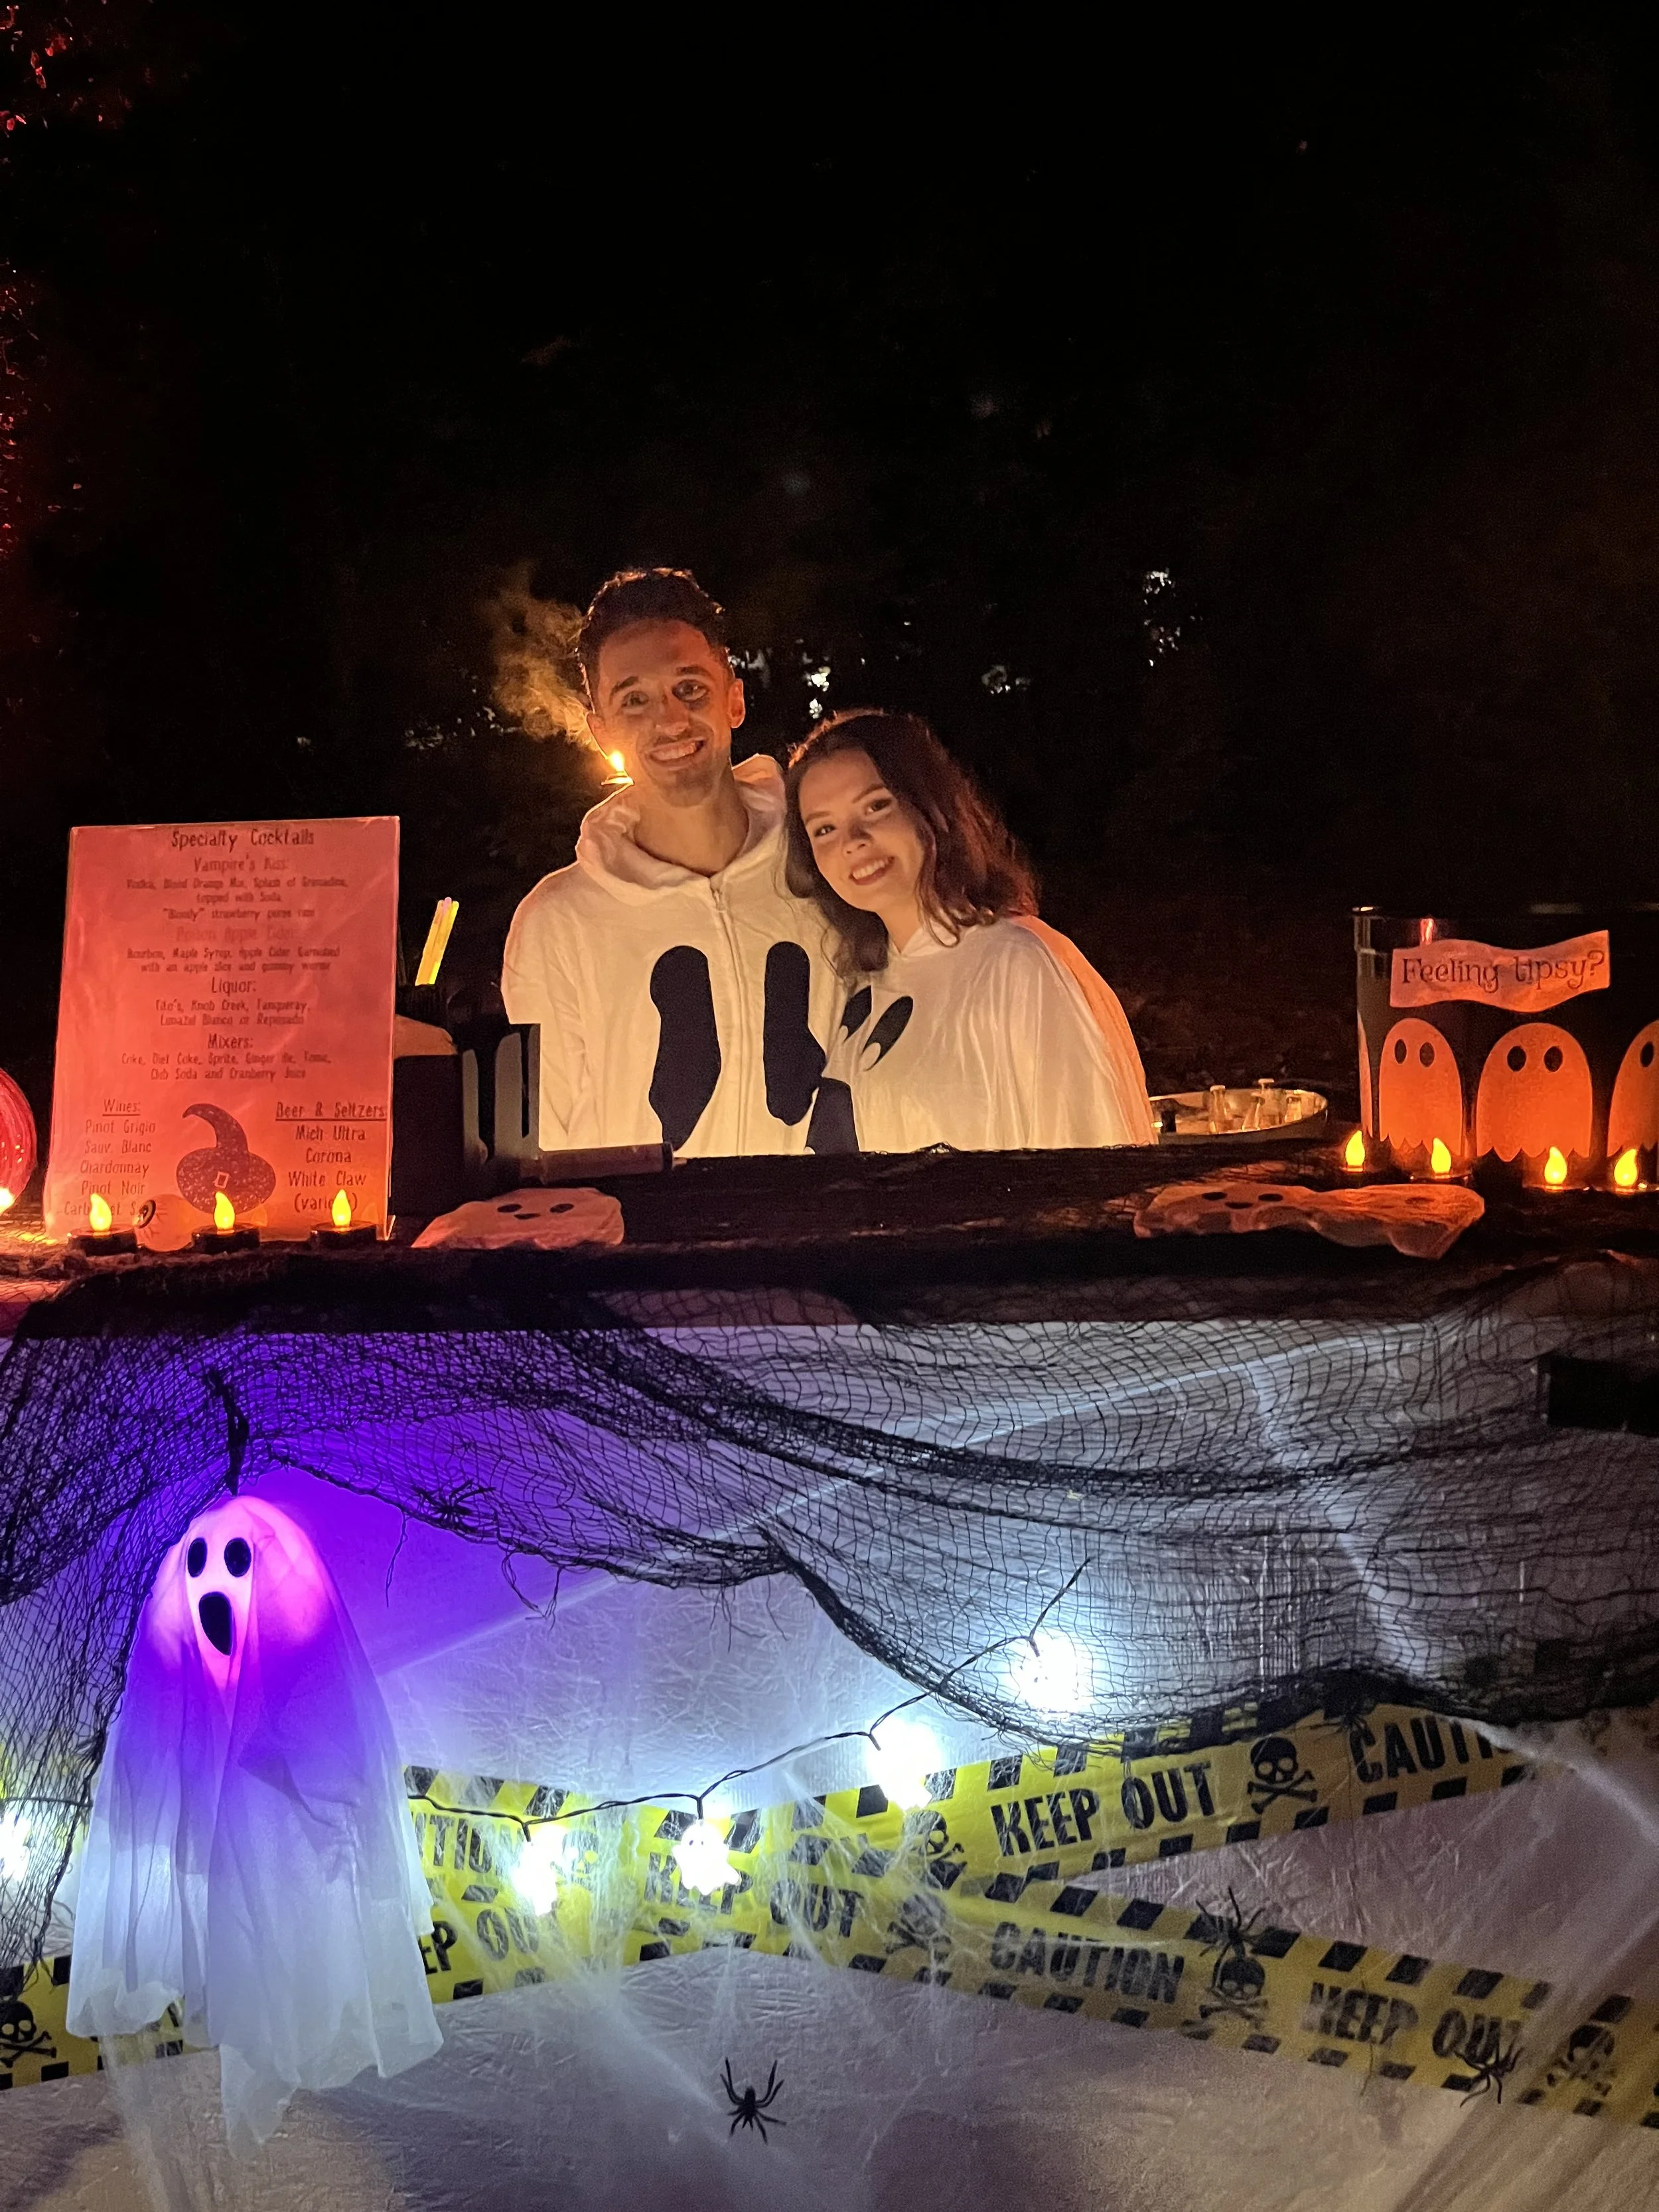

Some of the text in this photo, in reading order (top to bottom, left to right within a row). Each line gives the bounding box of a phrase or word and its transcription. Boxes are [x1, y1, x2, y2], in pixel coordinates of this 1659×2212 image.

[171, 828, 315, 852] Specialty Cocktails
[194, 853, 255, 873] Vampire's
[287, 877, 295, 887] of
[197, 893, 229, 905] topped
[235, 893, 254, 902] with
[212, 909, 259, 921] strawberry
[127, 948, 165, 960] Bourbon,
[173, 948, 198, 958] Maple
[141, 962, 160, 972] with
[183, 962, 208, 974] apple
[239, 962, 255, 971] and
[1402, 949, 1605, 994] Feeling tipsy?
[212, 976, 257, 996] Liquor:
[155, 999, 184, 1013] Tito's,
[191, 1000, 214, 1011] Knob
[222, 999, 249, 1011] Creek,
[239, 1015, 250, 1025] or
[207, 1033, 254, 1049] Mixers:
[152, 1053, 170, 1064] Diet
[246, 1053, 275, 1066] Ginger
[151, 1069, 169, 1080] Club
[176, 1068, 197, 1080] Soda
[204, 1068, 223, 1078] and
[230, 1068, 275, 1082] Cranberry
[104, 1099, 141, 1112] Wines:
[276, 1102, 304, 1118] Beer
[315, 1102, 323, 1116] &
[86, 1119, 156, 1136] Pinot Grigio
[296, 1125, 366, 1141] Mich Ultra
[121, 1140, 151, 1153] Blanc
[306, 1147, 352, 1163] Corona
[80, 1160, 149, 1179] Chardonnay
[289, 1170, 366, 1187] White Claw
[82, 1180, 145, 1195] Pinot Noir
[991, 1789, 1100, 1857] KEEP
[1120, 1761, 1215, 1830] OUT
[769, 1878, 865, 1939] OUT
[989, 1921, 1185, 2004] CAUTION
[1299, 1981, 1419, 2045] KEEP
